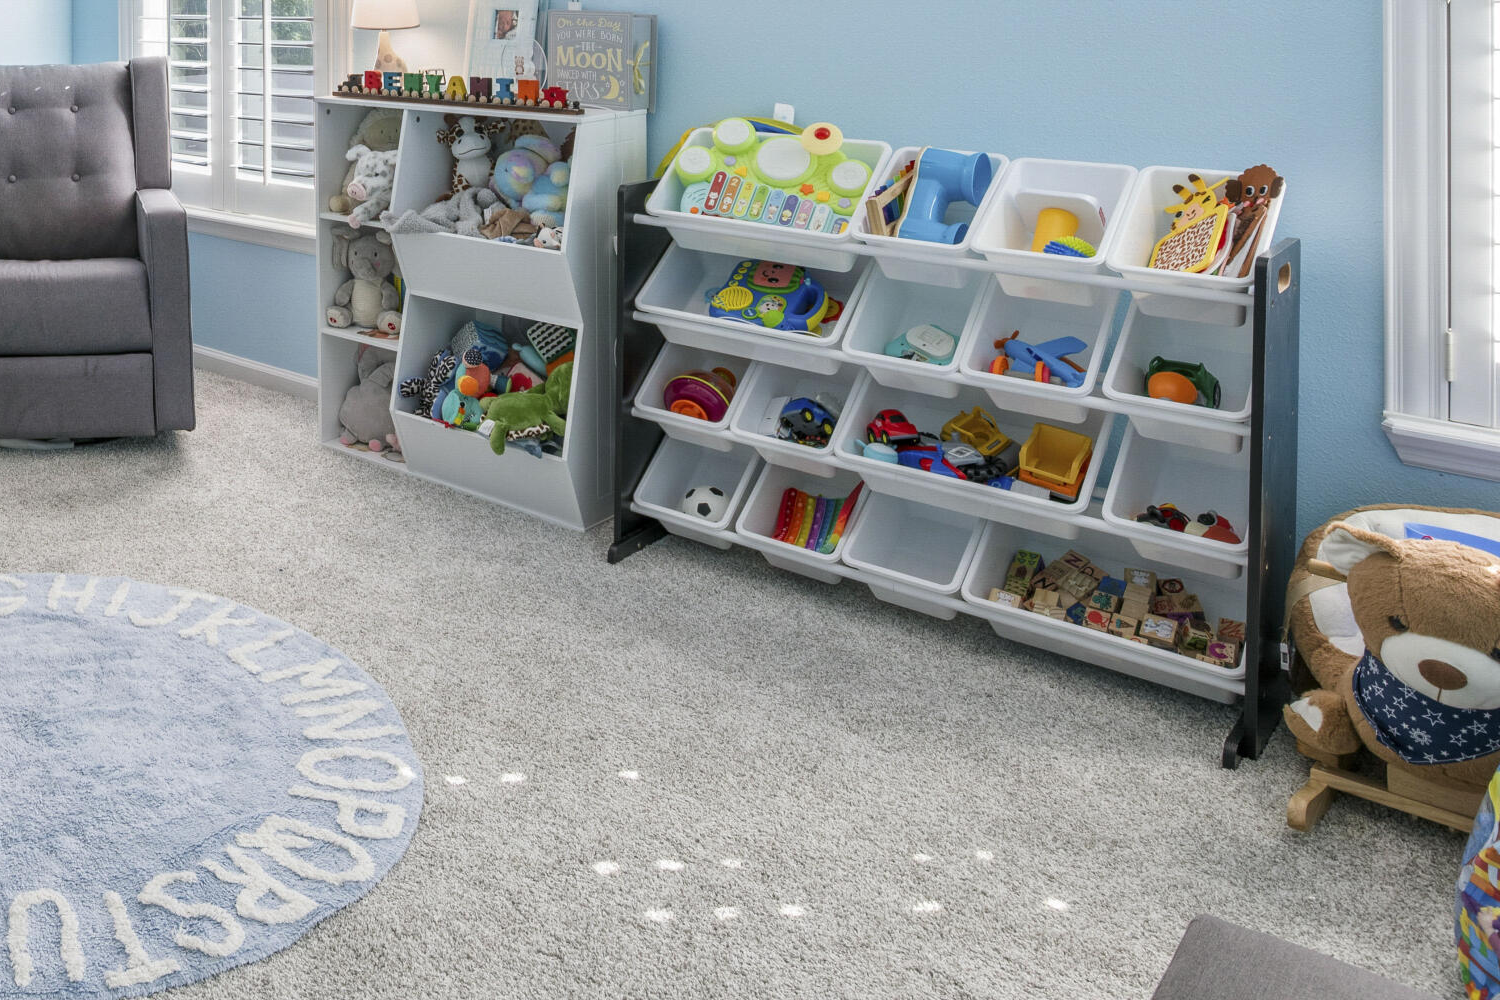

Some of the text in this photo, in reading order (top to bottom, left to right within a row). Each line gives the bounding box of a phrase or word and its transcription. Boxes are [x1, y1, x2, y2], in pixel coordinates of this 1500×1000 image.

[556, 17, 624, 33] On the Day
[556, 29, 623, 44] YOU WERE BORN
[580, 41, 596, 52] THE
[555, 44, 623, 73] MOON
[581, 70, 597, 82] WITH
[718, 174, 723, 183] 1
[730, 178, 739, 186] 2
